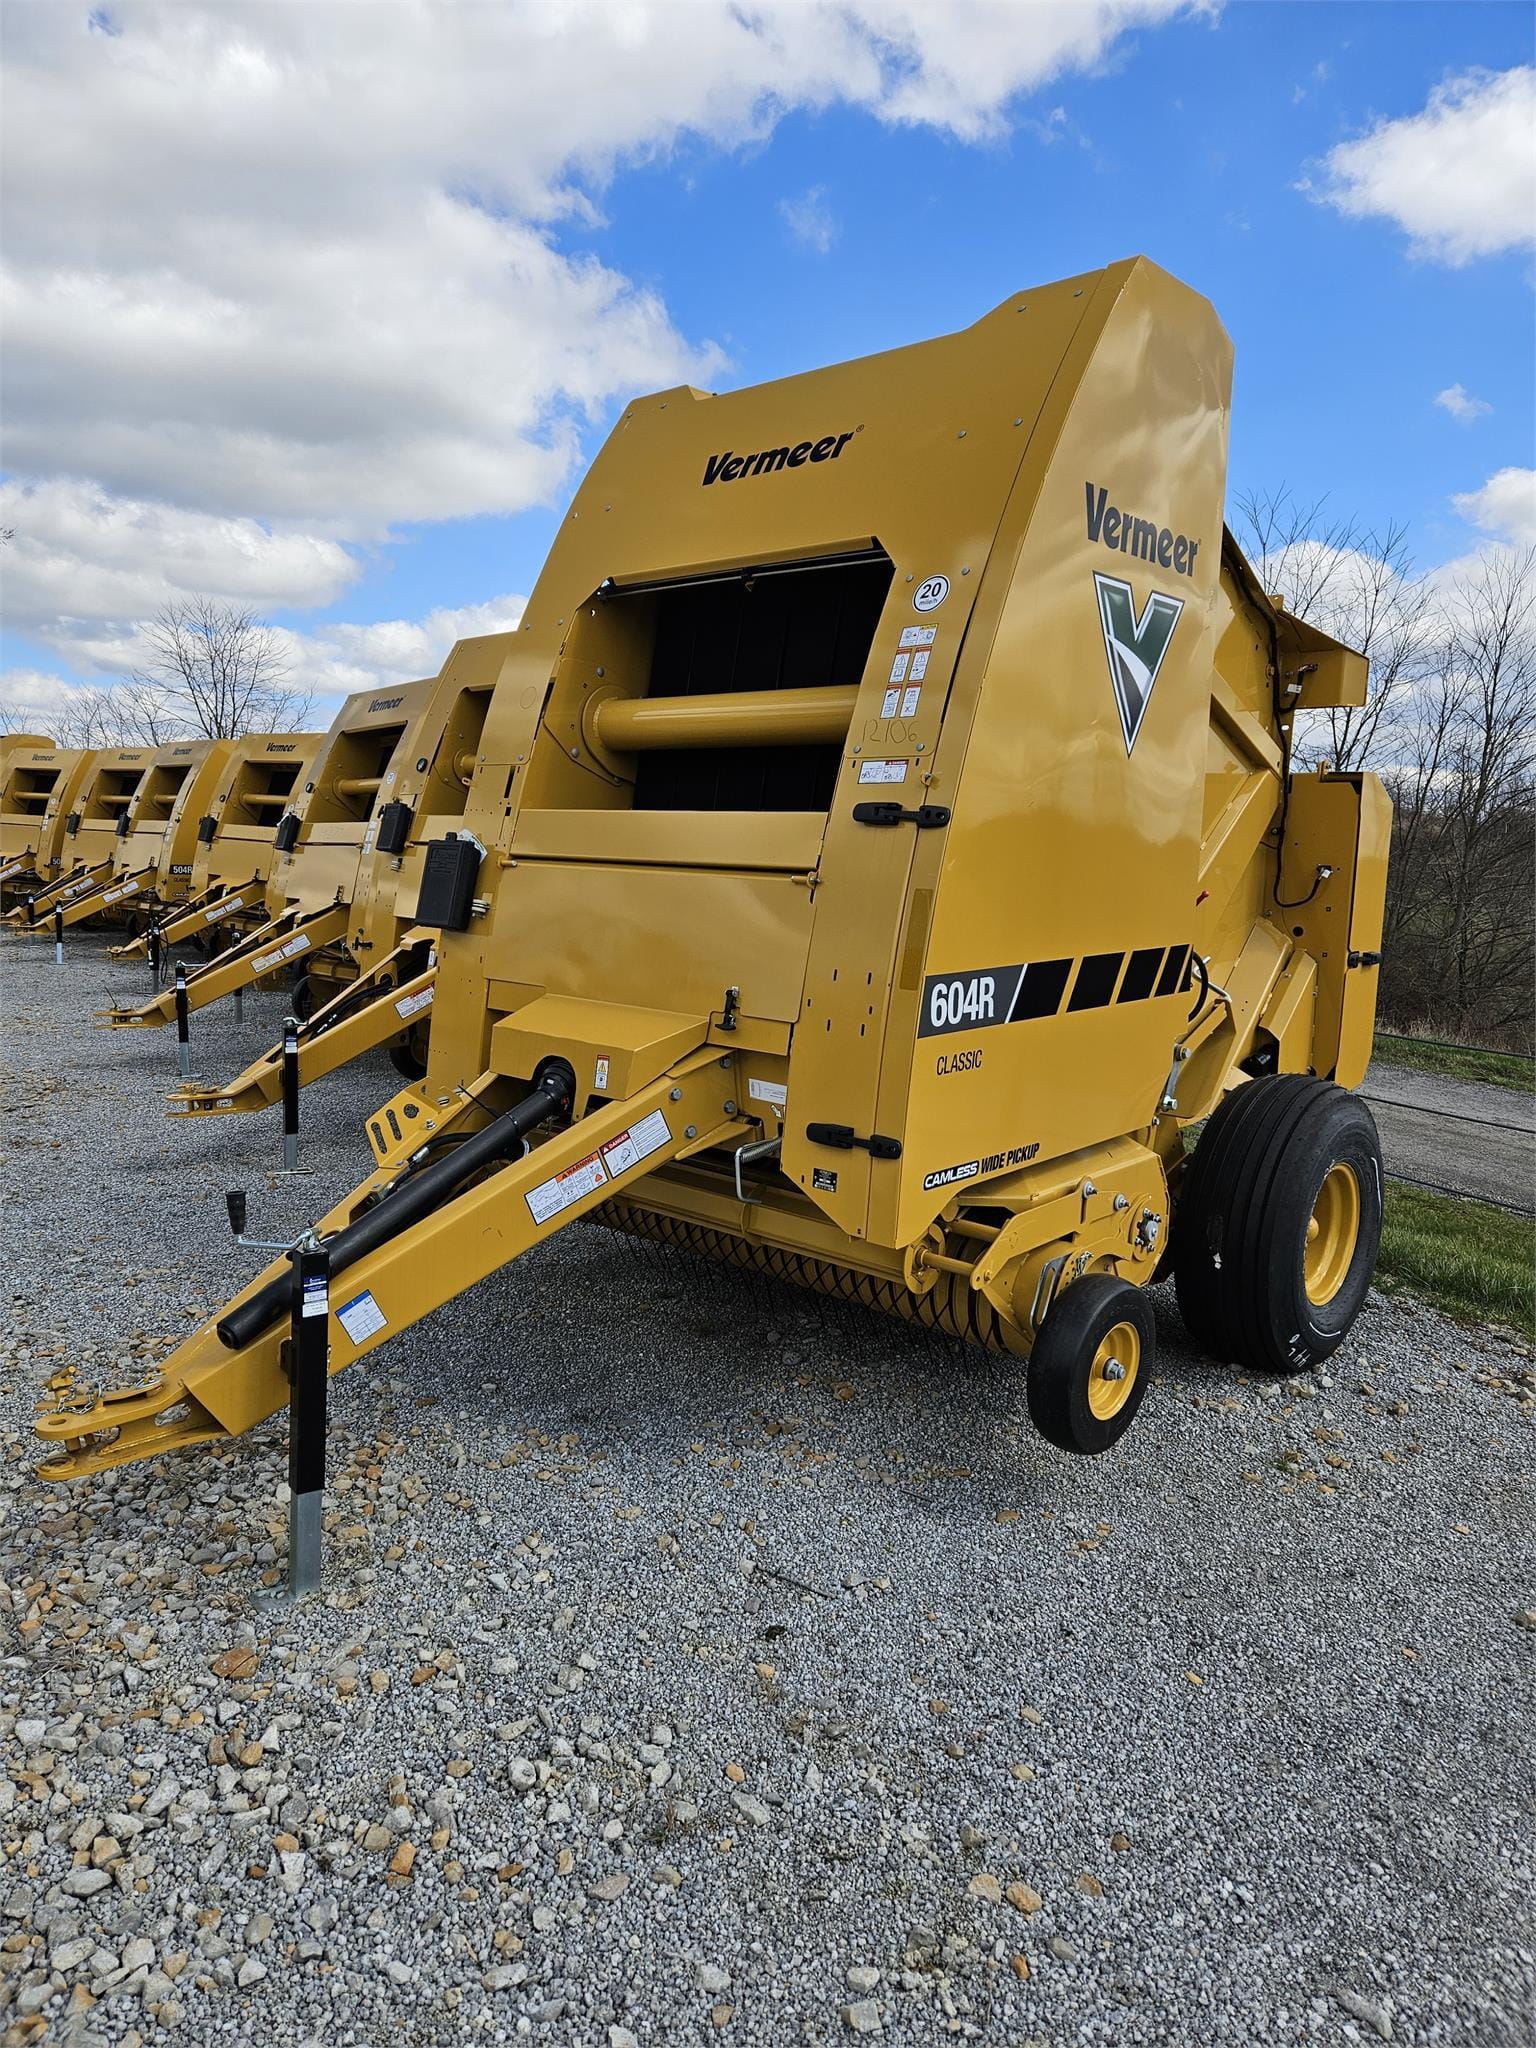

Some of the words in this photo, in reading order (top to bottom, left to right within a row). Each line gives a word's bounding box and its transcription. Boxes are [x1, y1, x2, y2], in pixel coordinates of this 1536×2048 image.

[702, 432, 855, 486] Vermeer
[1085, 481, 1198, 577] Vermeer
[920, 582, 942, 599] 20
[367, 697, 404, 713] Vermeer
[265, 742, 297, 752] Vermeer
[930, 976, 995, 1028] 604R
[936, 1049, 983, 1076] CLASSIC
[566, 1155, 595, 1177] WARNING
[924, 1162, 979, 1189] CAMLESS
[981, 1152, 1006, 1174] WIDE
[1006, 1143, 1040, 1167] PICKUP
